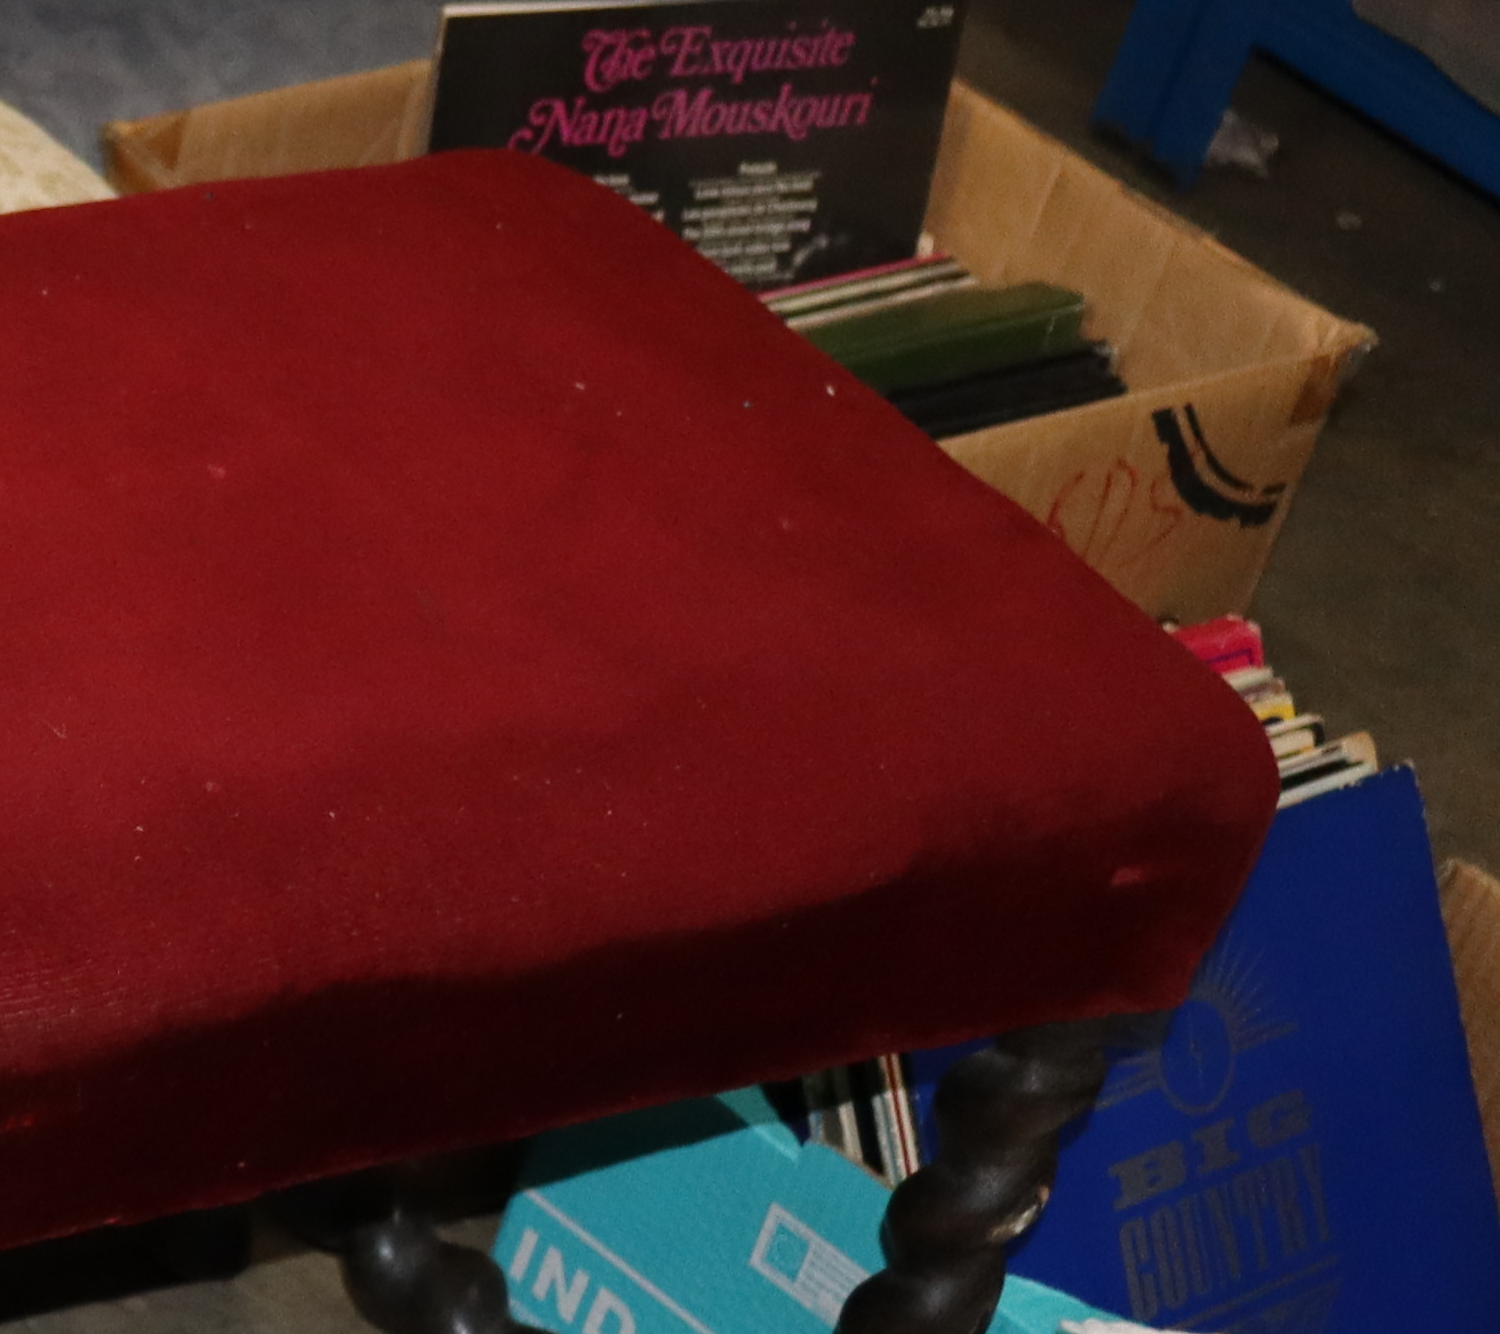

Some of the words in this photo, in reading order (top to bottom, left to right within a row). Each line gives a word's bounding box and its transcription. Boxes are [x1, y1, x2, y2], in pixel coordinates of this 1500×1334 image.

[581, 28, 657, 93] The
[660, 19, 857, 85] Exquisite
[508, 95, 649, 158] Nana
[652, 76, 879, 142] Mouskouri
[1108, 1088, 1315, 1211] BIG
[1118, 1142, 1332, 1321] COUNTRY
